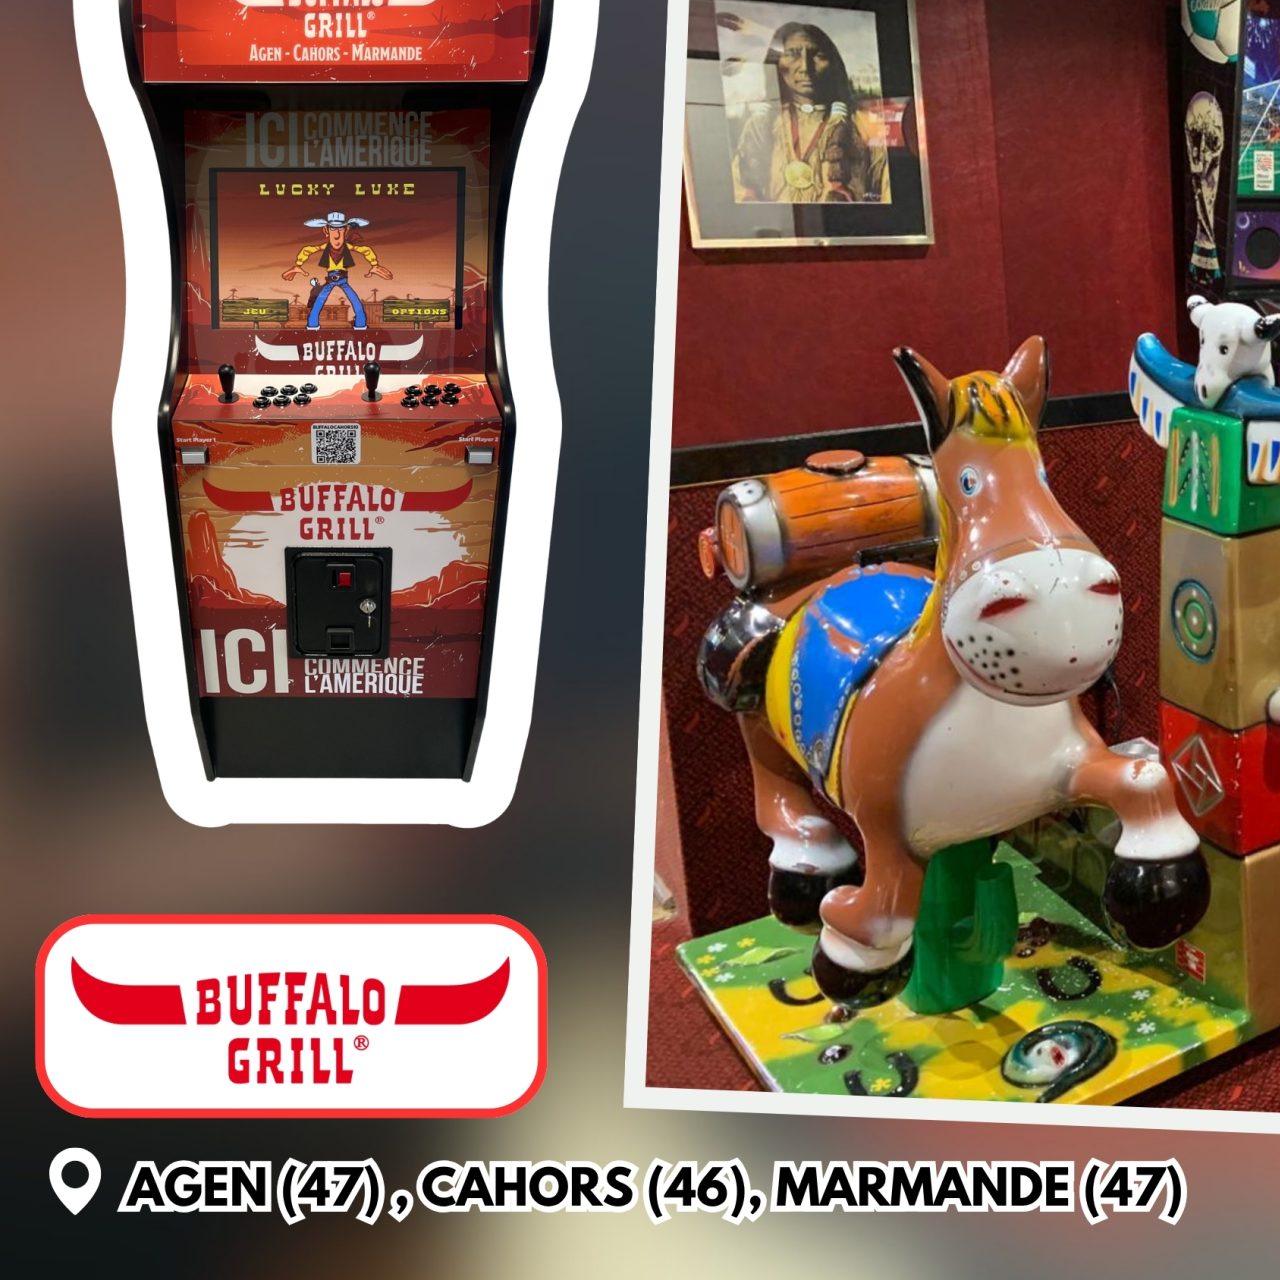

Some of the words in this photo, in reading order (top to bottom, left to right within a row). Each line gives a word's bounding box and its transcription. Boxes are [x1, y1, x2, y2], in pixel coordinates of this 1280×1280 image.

[249, 44, 283, 62] AGEN
[293, 44, 341, 63] CAHORS
[351, 44, 423, 63] MARMANDE
[302, 111, 433, 140] COMMENCE
[245, 111, 299, 168] ICI
[302, 134, 433, 168] L'AMERIQUE
[259, 183, 336, 197] LUCKY
[354, 183, 417, 197] LUKE
[243, 307, 267, 316] JEU
[391, 307, 448, 317] OPTIONS
[302, 340, 377, 362] BUFFALO
[280, 484, 396, 513] BUFFALO
[200, 628, 290, 694] ICI
[304, 656, 425, 677] COMMENCE
[304, 672, 425, 695] L'AMERIQUE
